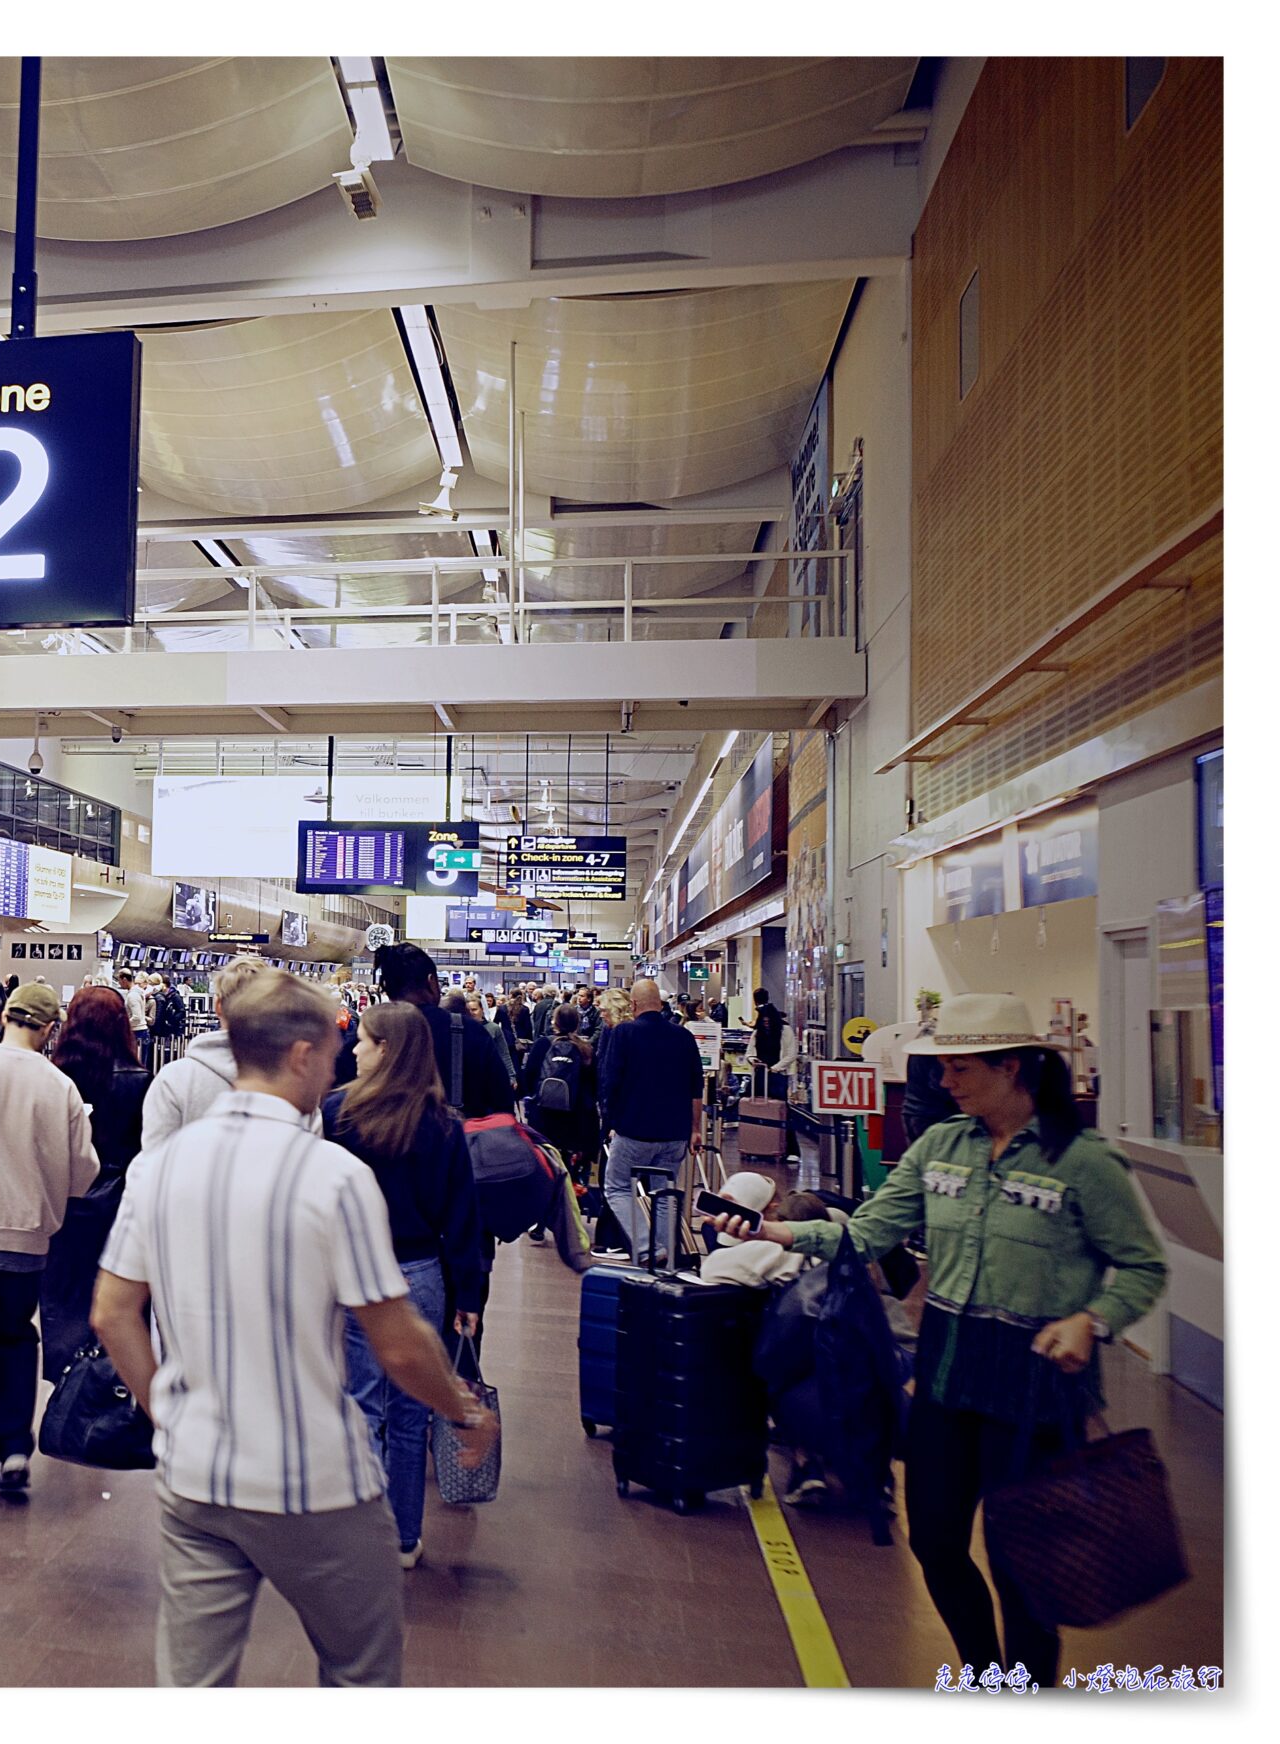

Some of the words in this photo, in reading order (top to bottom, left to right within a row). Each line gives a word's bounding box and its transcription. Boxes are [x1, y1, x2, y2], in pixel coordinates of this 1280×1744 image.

[428, 831, 459, 842] Zone
[521, 853, 561, 863] Check-in
[562, 854, 584, 863] zone
[585, 853, 611, 866] 4-7
[822, 1070, 873, 1106] EXIT
[765, 1541, 800, 1575] STOP
